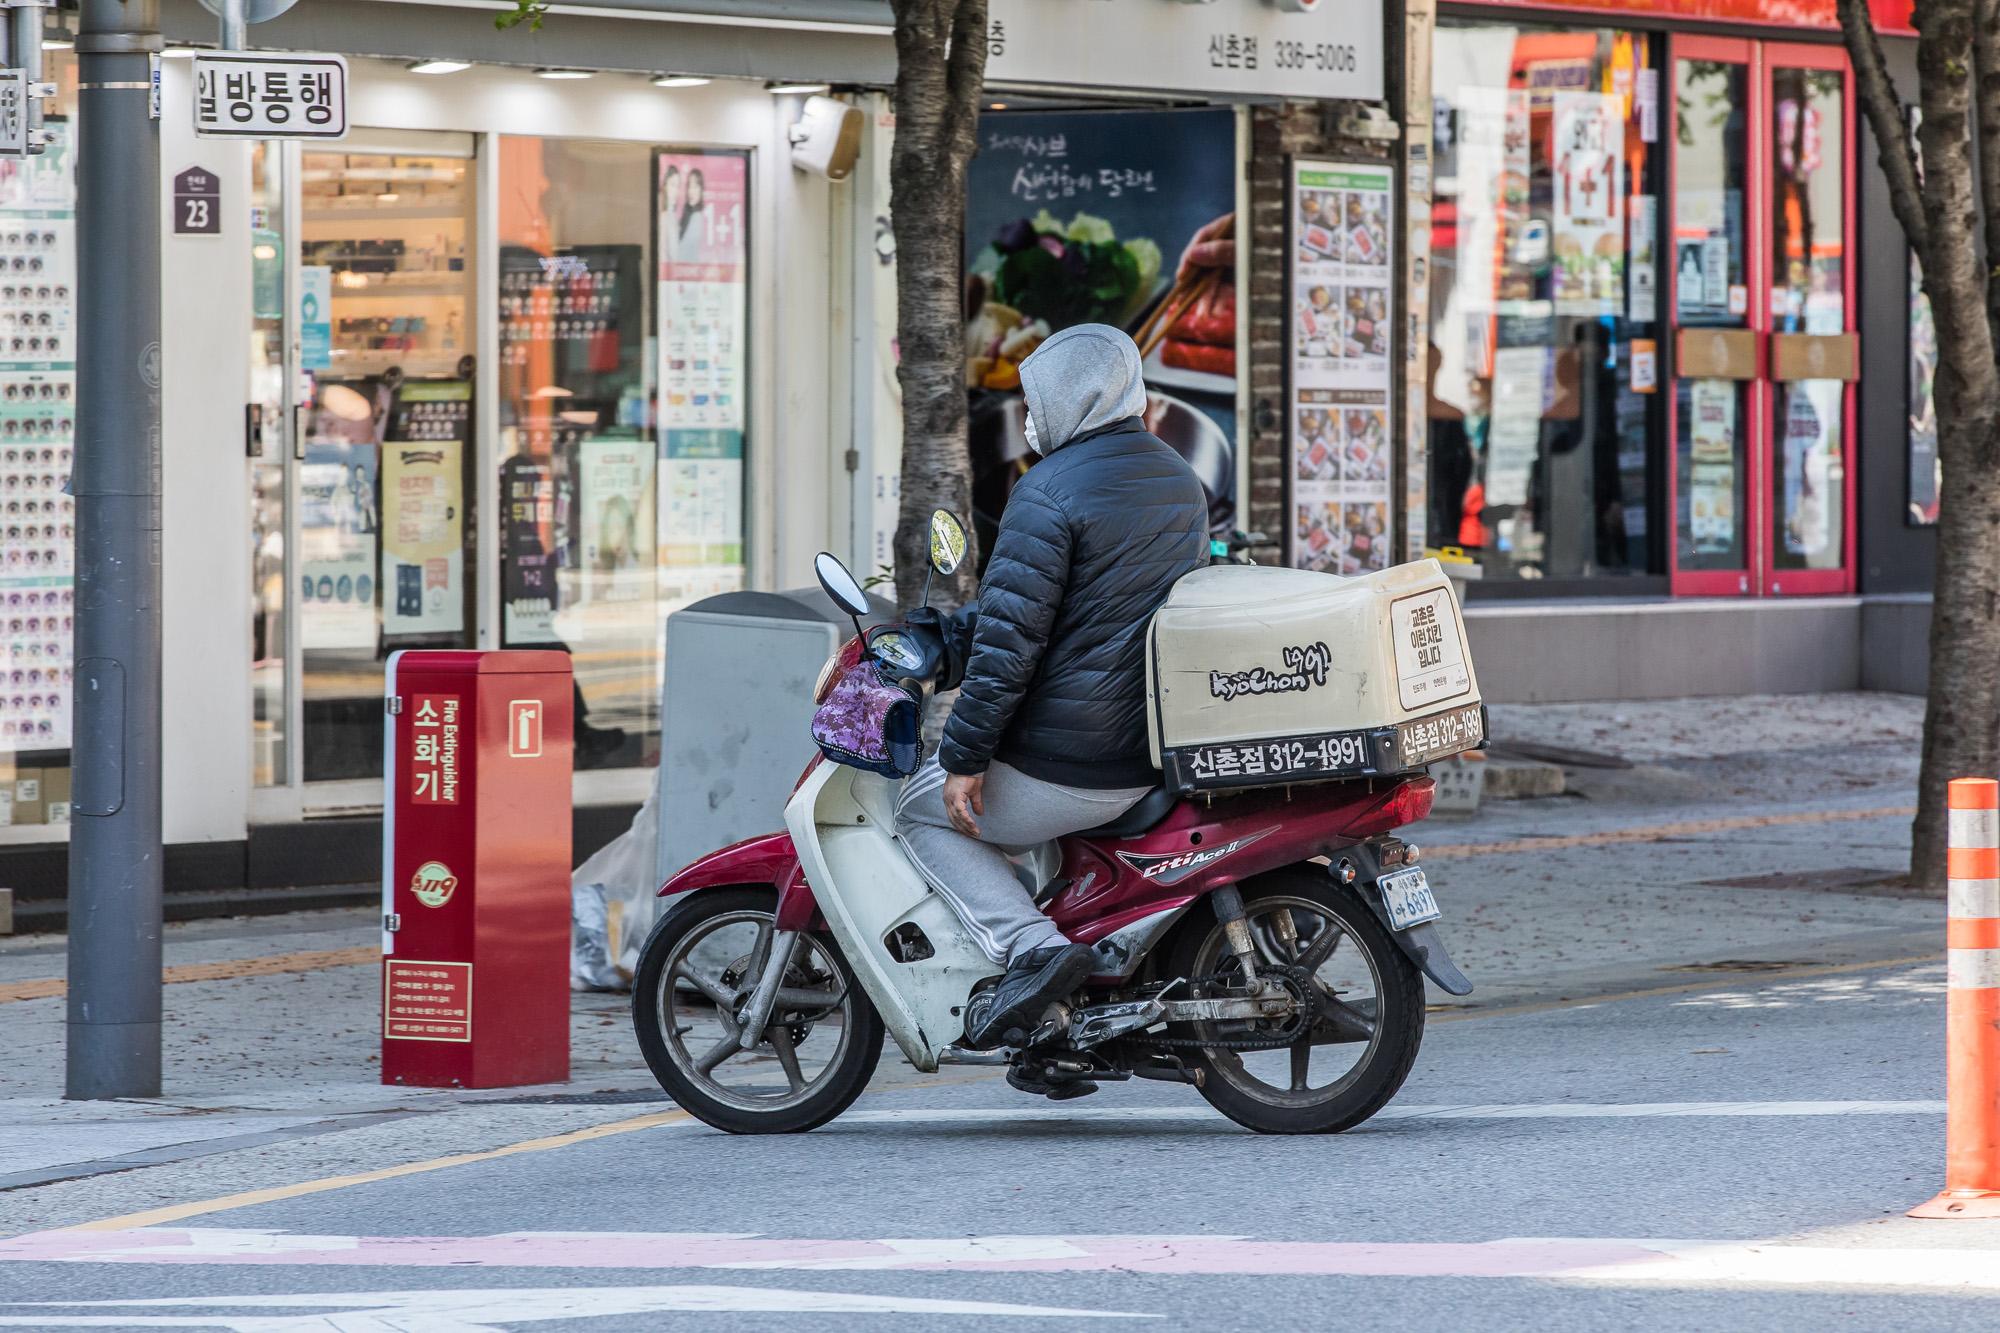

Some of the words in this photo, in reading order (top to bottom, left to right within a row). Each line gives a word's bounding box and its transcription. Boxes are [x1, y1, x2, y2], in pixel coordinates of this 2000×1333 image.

[1208, 33, 1258, 70] 신촌점
[1275, 40, 1356, 72] 336-5006
[199, 69, 332, 124] 일방통행
[185, 200, 209, 228] 23
[703, 202, 742, 248] 1+1
[1411, 604, 1436, 627] 교촌은
[1410, 628, 1428, 649] 이런
[1426, 624, 1443, 644] 치킨
[1418, 645, 1442, 669] 입니다
[443, 700, 459, 723] Fire
[1402, 721, 1441, 756] 신촌점
[1440, 707, 1483, 745] 312-1991
[414, 699, 440, 801] 소화기
[440, 724, 459, 801] Extinguisher
[1190, 746, 1266, 779] 신촌점
[1269, 736, 1365, 771] 312-1991
[421, 877, 456, 898] 119
[1405, 888, 1435, 916] 6897
